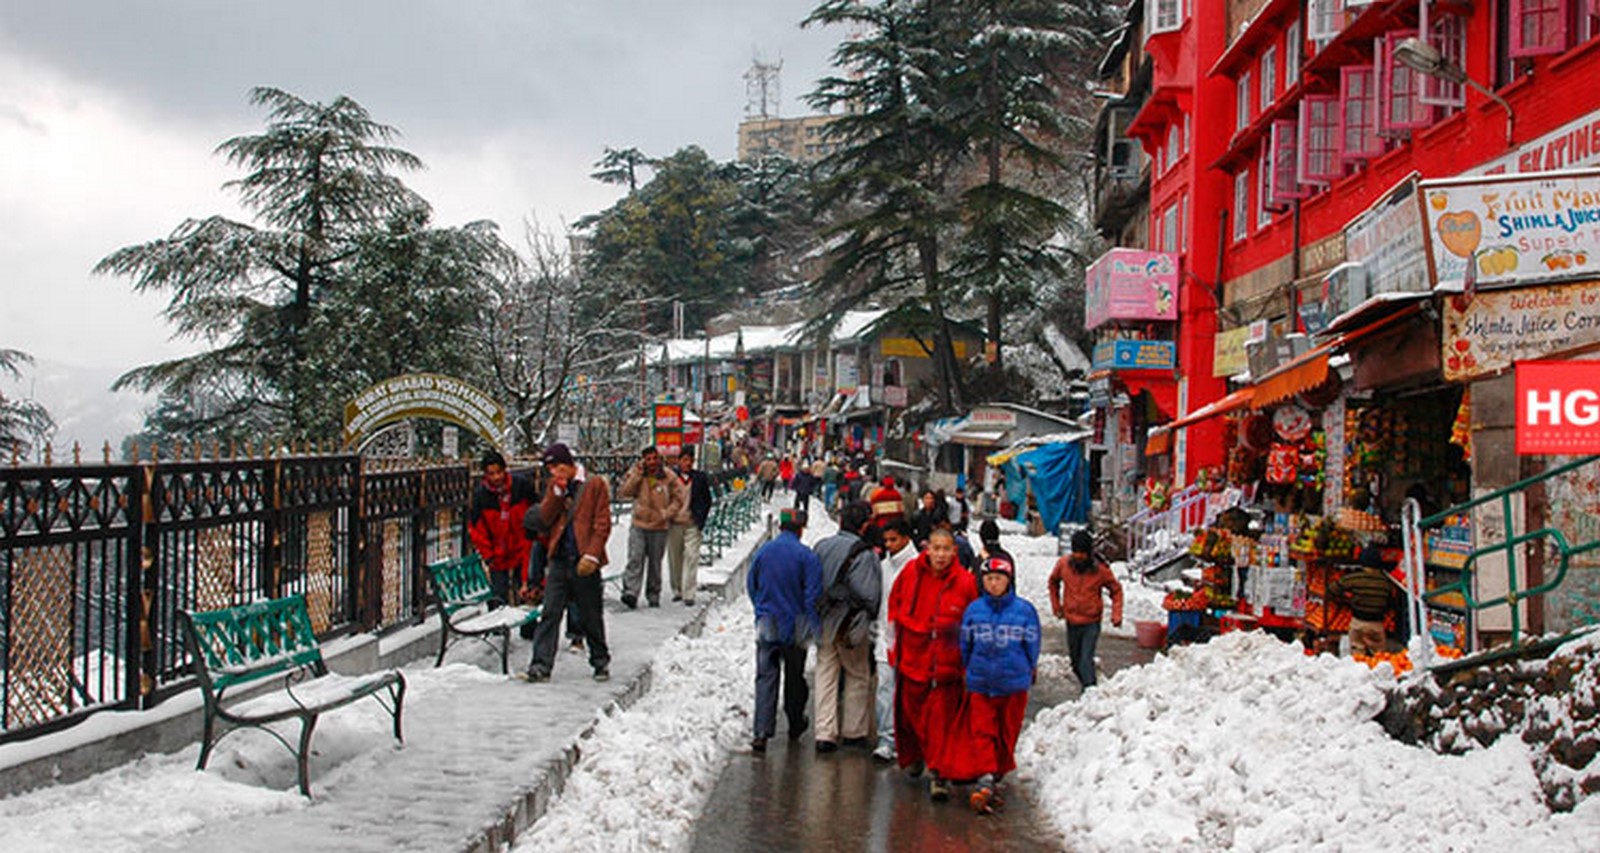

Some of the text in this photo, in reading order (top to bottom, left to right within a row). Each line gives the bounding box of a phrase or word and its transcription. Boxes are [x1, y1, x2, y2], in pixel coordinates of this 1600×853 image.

[1499, 213, 1564, 238] SHIMLA
[1562, 207, 1600, 232] JUIC
[1518, 231, 1585, 253] Super
